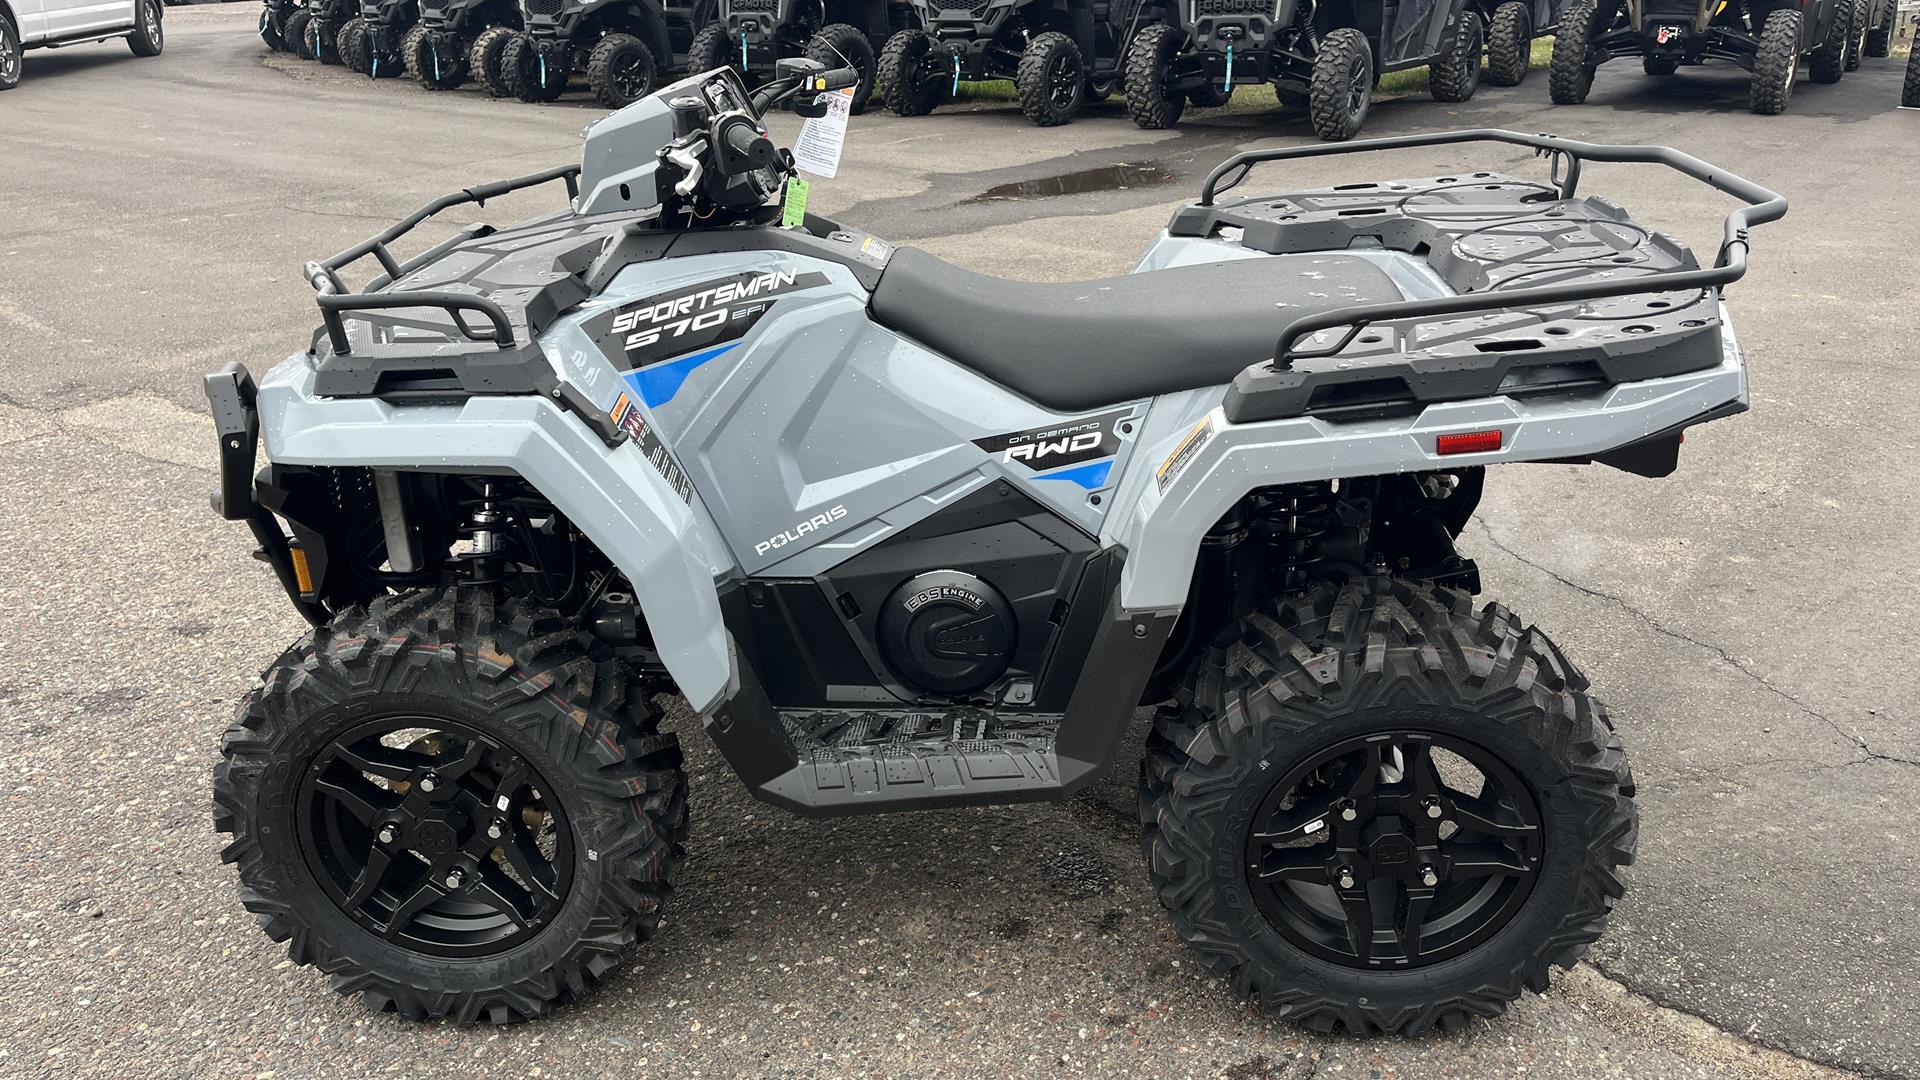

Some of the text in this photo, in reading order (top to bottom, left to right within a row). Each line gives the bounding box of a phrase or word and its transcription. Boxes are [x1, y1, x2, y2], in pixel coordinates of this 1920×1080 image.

[1203, 0, 1266, 9] CFMOTO
[611, 267, 797, 334] SPORTSMAN
[624, 304, 766, 351] 570 EFI
[1002, 431, 1103, 464] AWD
[1008, 422, 1100, 444] ON DEMAND
[754, 504, 848, 556] POLARIS
[907, 588, 939, 609] EBS
[942, 588, 983, 606] ENGINE
